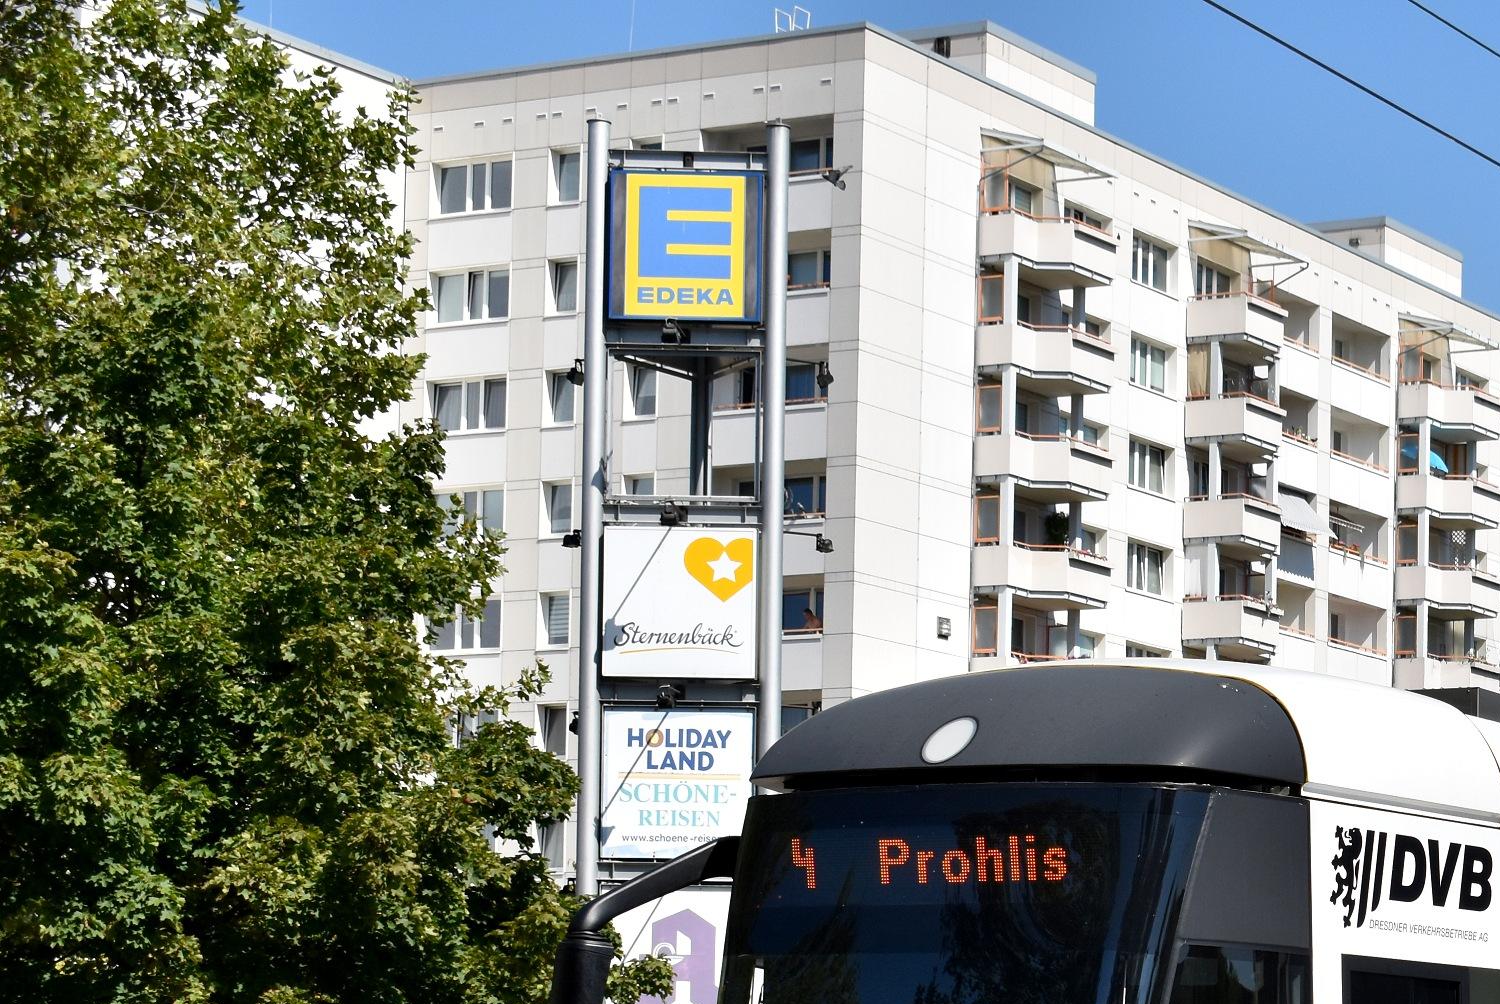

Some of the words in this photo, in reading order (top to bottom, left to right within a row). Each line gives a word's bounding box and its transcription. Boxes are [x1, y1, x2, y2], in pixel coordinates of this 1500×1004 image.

[638, 186, 732, 279] E
[637, 286, 734, 305] EDEKA
[614, 622, 744, 647] Sternenbäck
[627, 728, 732, 749] HOLIDAY
[646, 750, 715, 772] LAND
[619, 780, 737, 804] SCHÖNE-
[638, 809, 720, 827] REISEN
[791, 838, 816, 889] 4
[878, 834, 1067, 885] Prohlis
[1389, 834, 1493, 912] DVB
[1369, 919, 1408, 933] DRESDNER
[1409, 924, 1478, 941] VERKEHRSBETRIEBE
[1478, 932, 1489, 942] AG
